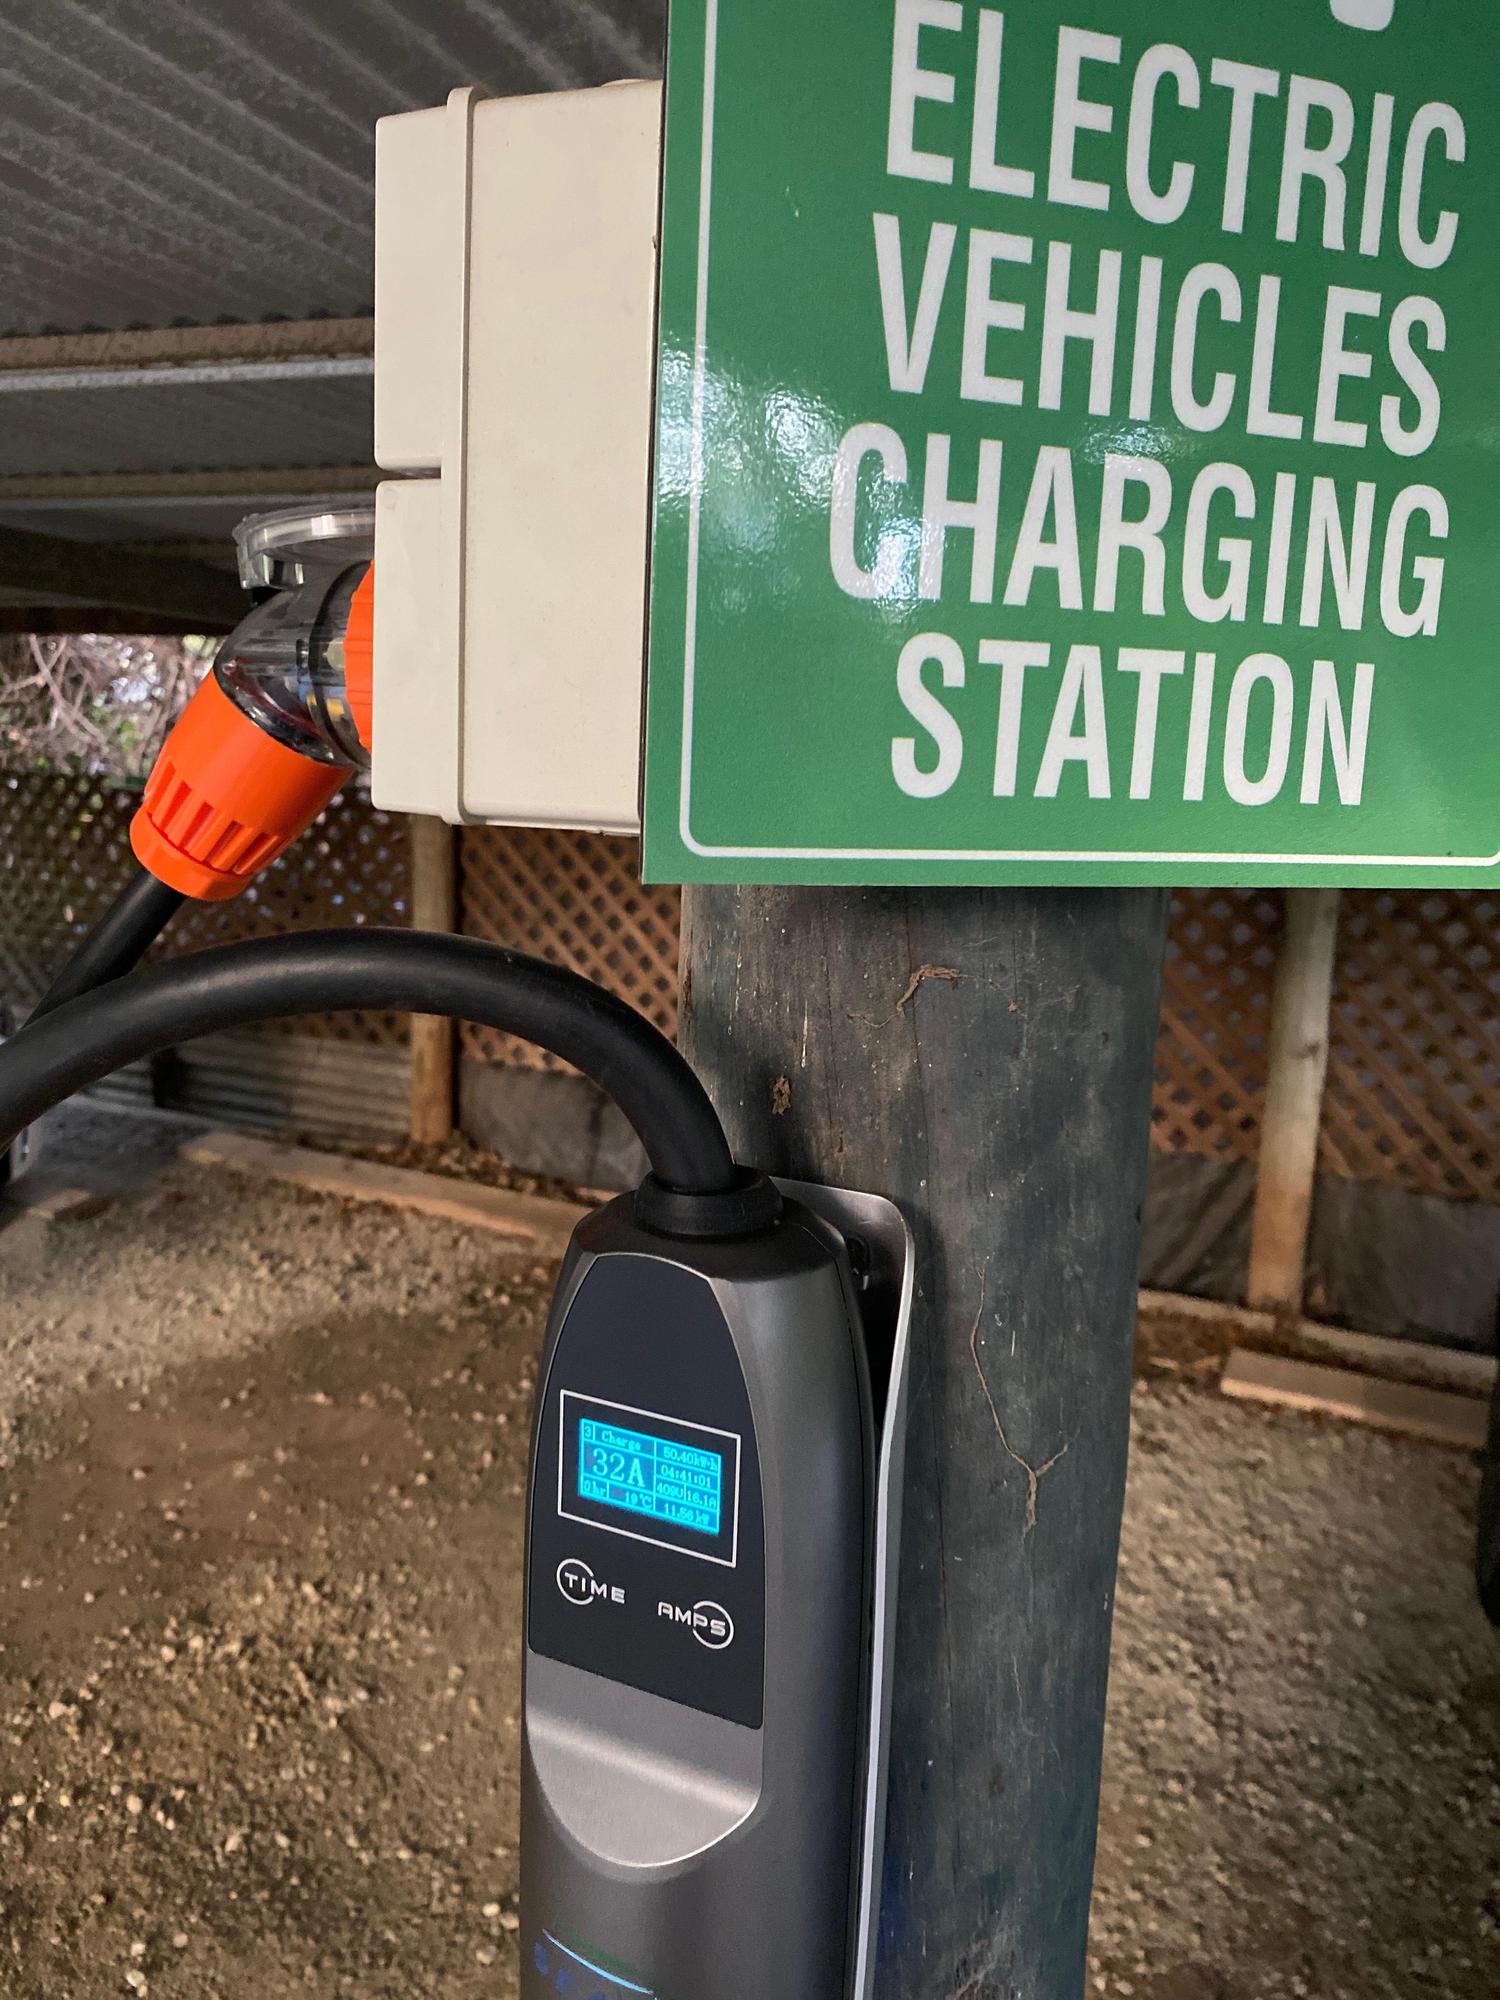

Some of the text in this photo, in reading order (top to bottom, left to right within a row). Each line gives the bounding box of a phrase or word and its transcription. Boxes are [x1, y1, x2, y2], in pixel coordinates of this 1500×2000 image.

[886, 0, 1466, 269] ELECTRIC
[872, 212, 1447, 457] VEHICLES
[829, 421, 1450, 638] CHARGING
[890, 632, 1375, 806] STATION
[592, 1447, 646, 1488] 32A
[601, 1430, 641, 1451] Charge
[563, 1571, 626, 1604] TIME
[657, 1600, 727, 1638] AMPS
